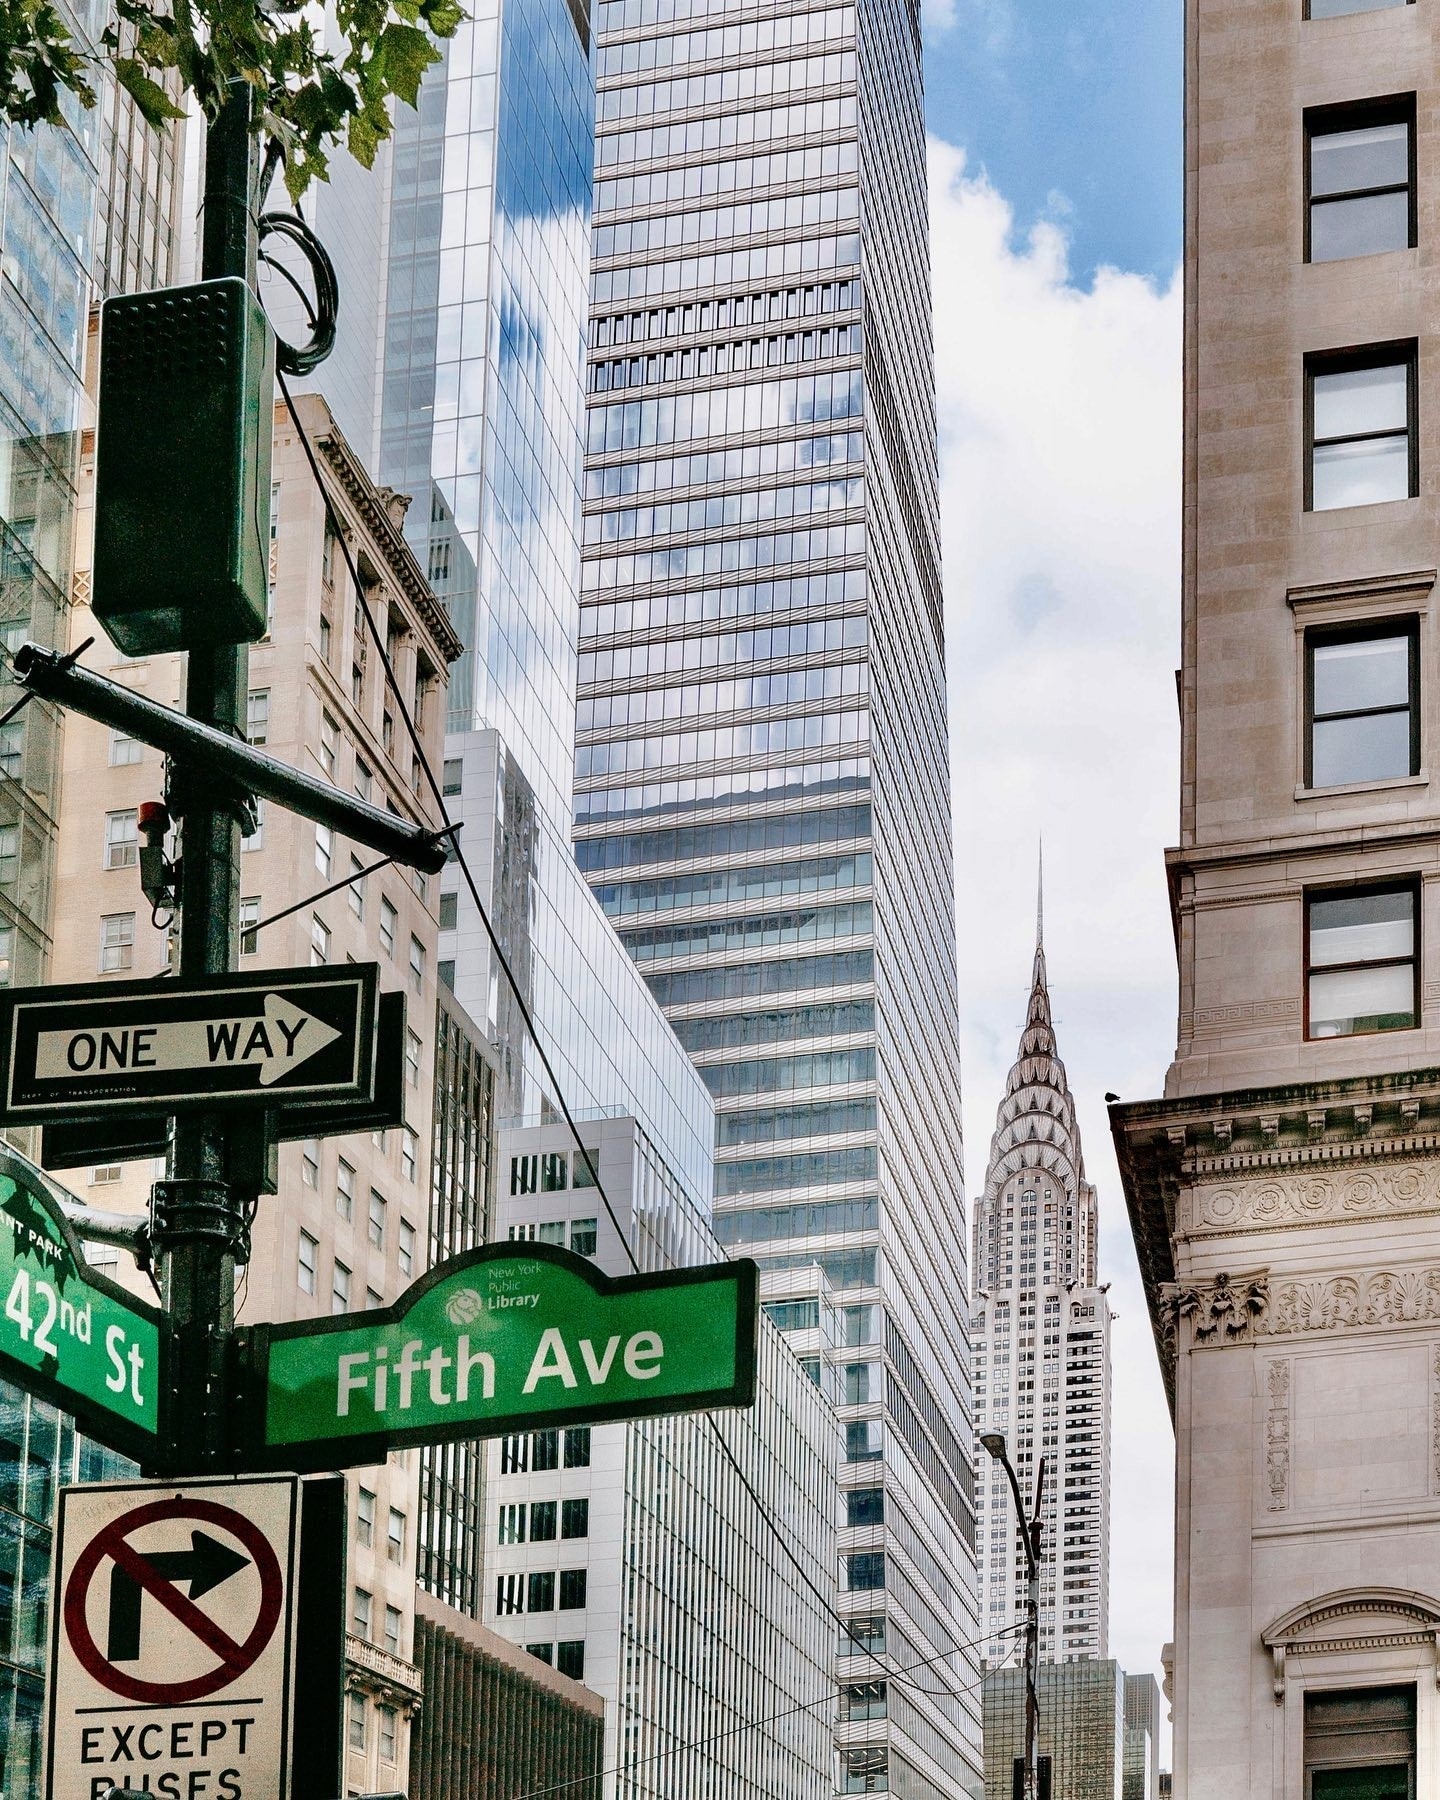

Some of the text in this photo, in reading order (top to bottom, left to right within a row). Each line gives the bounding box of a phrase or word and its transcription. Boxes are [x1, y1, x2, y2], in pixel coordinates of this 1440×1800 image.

[67, 1018, 308, 1071] ONE WAY
[69, 1087, 137, 1096] TRANSPORTATION
[29, 1229, 63, 1261] PARK
[488, 1262, 542, 1279] New York
[489, 1280, 521, 1293] Public
[488, 1293, 540, 1310] Library
[5, 1268, 144, 1406] 42nd St
[336, 1326, 664, 1417] Fifth Ave
[81, 1718, 255, 1764] EXCEPT
